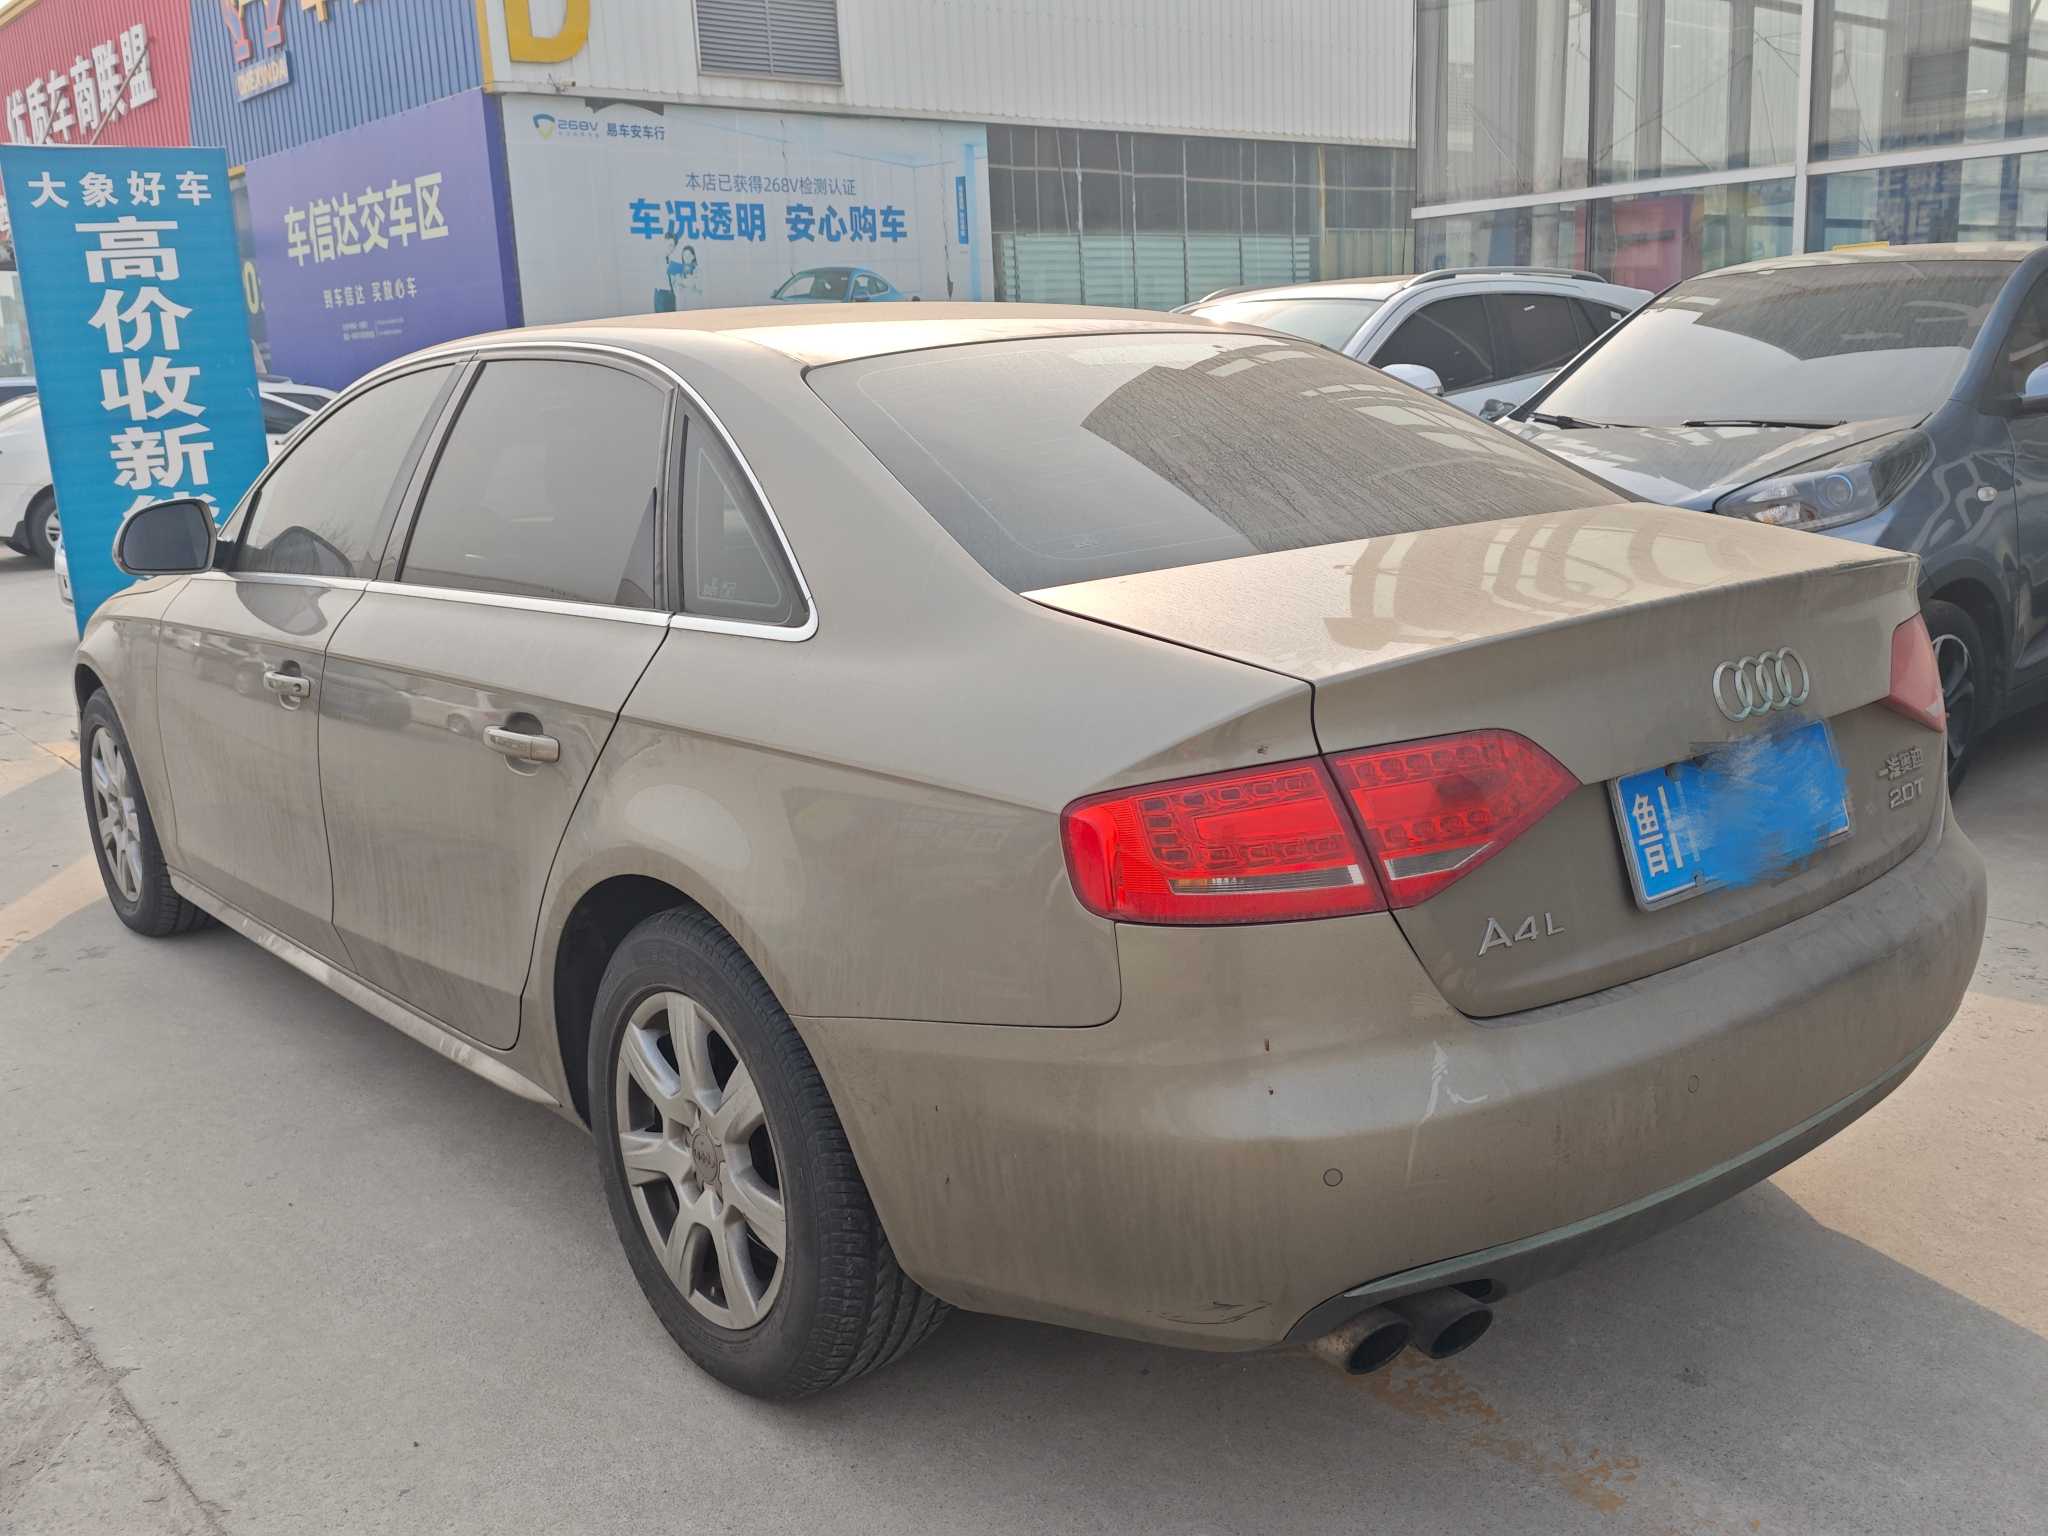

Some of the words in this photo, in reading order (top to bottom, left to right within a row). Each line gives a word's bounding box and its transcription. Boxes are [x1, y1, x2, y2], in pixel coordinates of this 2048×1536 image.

[27, 170, 212, 208] 大象好车
[685, 172, 857, 196] 本店已获得268V检测认证
[283, 172, 449, 267] 车信达交车区
[629, 198, 767, 242] 车况透明
[785, 204, 909, 243] 安心购车
[75, 216, 220, 528] 高价收新
[1477, 911, 1566, 957] A4L
